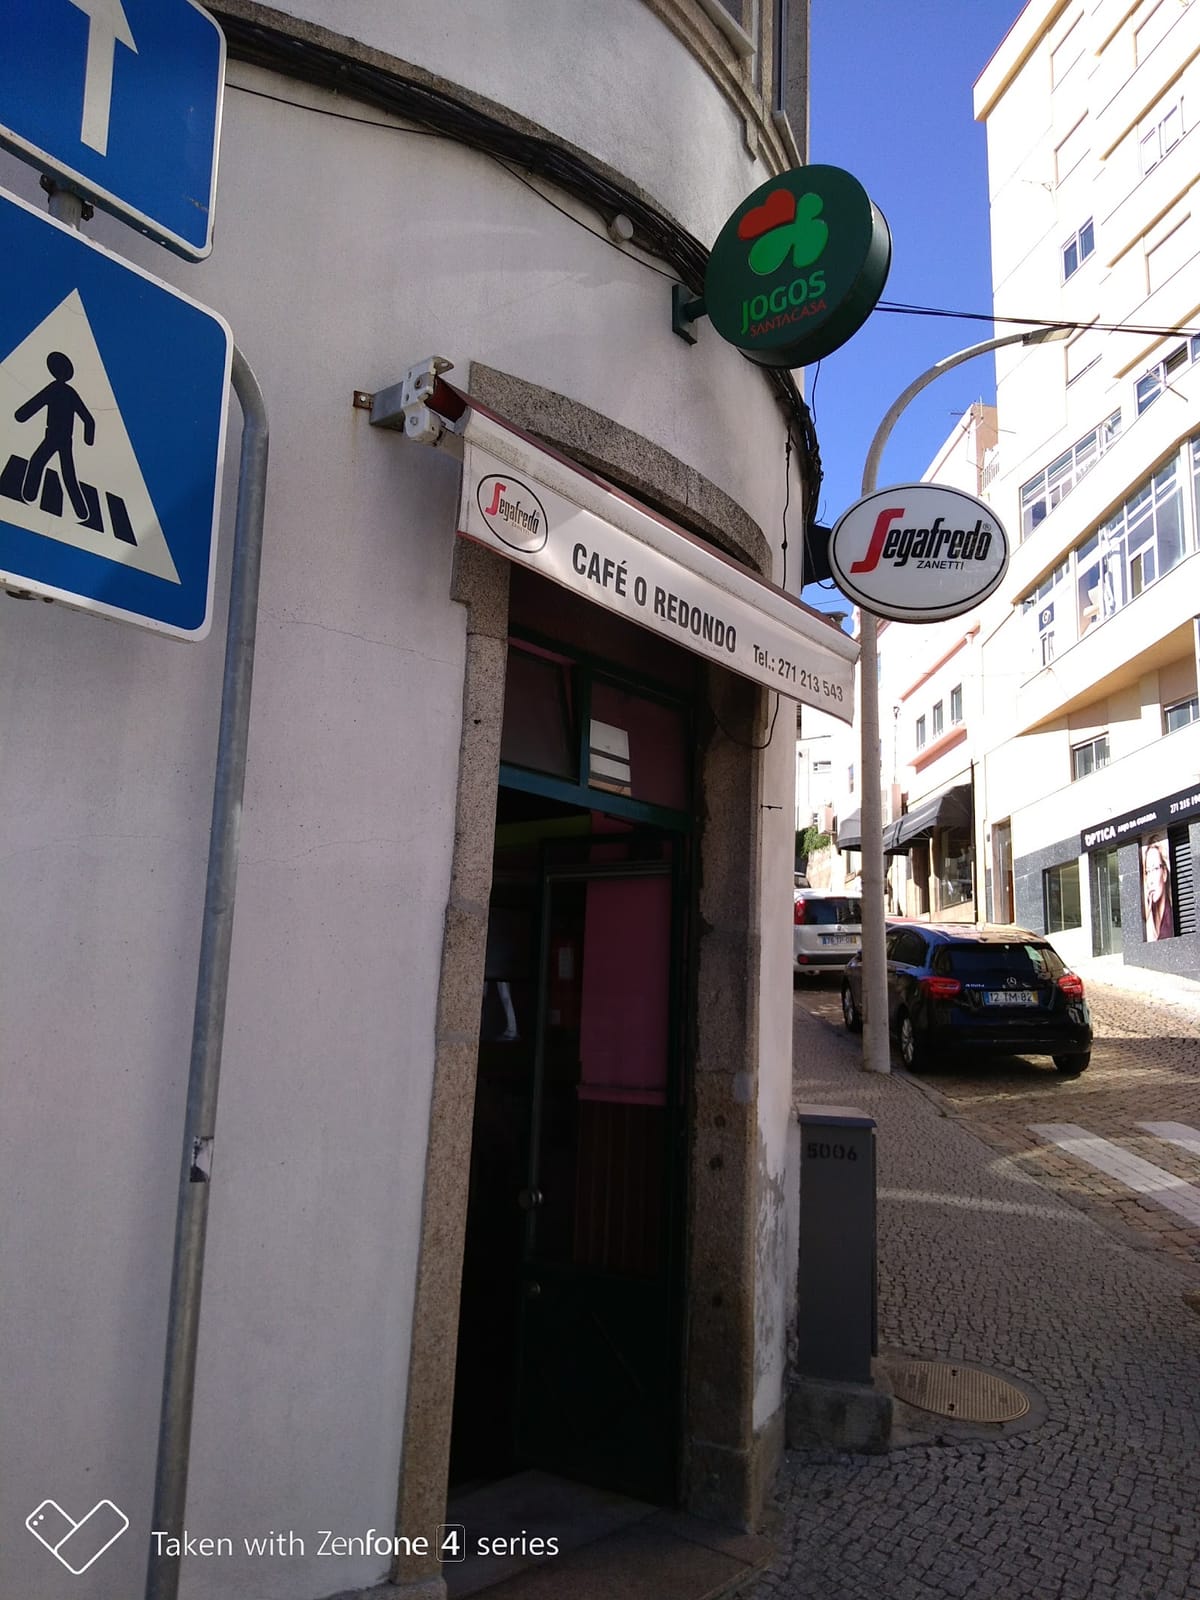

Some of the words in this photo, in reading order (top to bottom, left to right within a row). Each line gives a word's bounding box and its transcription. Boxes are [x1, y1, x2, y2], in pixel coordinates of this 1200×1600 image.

[741, 270, 826, 335] JOGOS
[485, 482, 540, 535] Segafredo
[850, 508, 992, 573] Segafredo
[916, 560, 964, 570] ZANETTI
[573, 543, 628, 597] CAFÉ
[634, 576, 647, 606] O
[654, 586, 736, 653] REDONDO
[753, 644, 775, 672] Tel.:
[778, 658, 796, 683] 271
[800, 669, 820, 693] 213
[823, 680, 843, 702] 543
[807, 1142, 857, 1161] 5006
